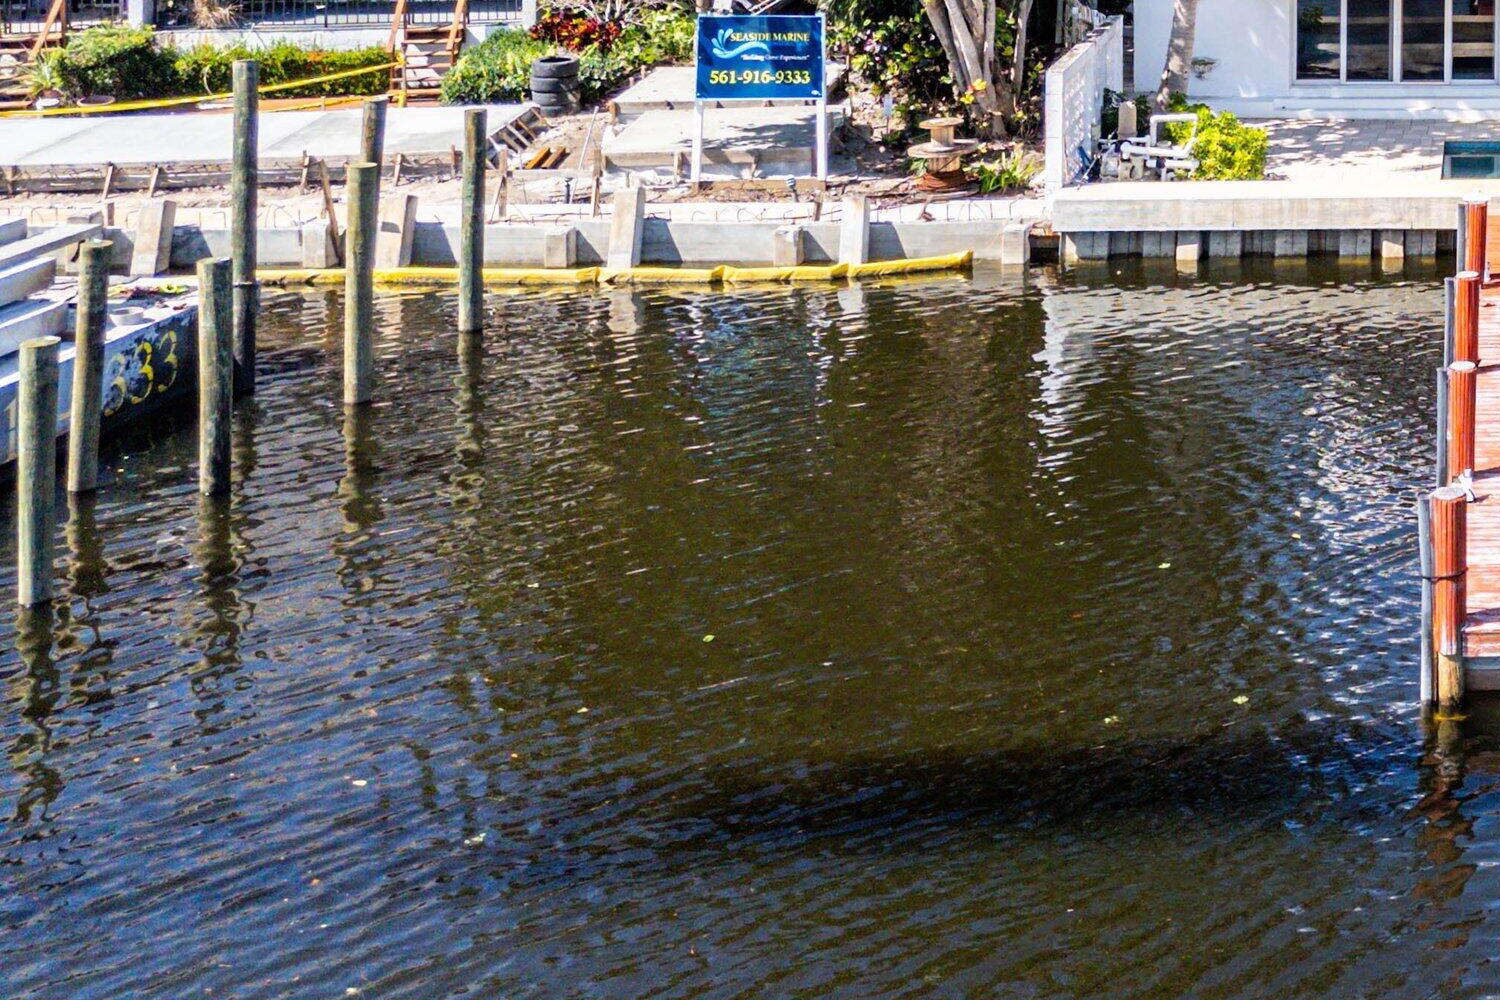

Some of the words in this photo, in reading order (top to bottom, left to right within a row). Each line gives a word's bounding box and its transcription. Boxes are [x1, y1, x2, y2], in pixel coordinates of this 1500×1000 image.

[730, 32, 771, 42] SEASIDE
[773, 32, 809, 42] MARINE
[710, 70, 810, 84] 561-916-9333
